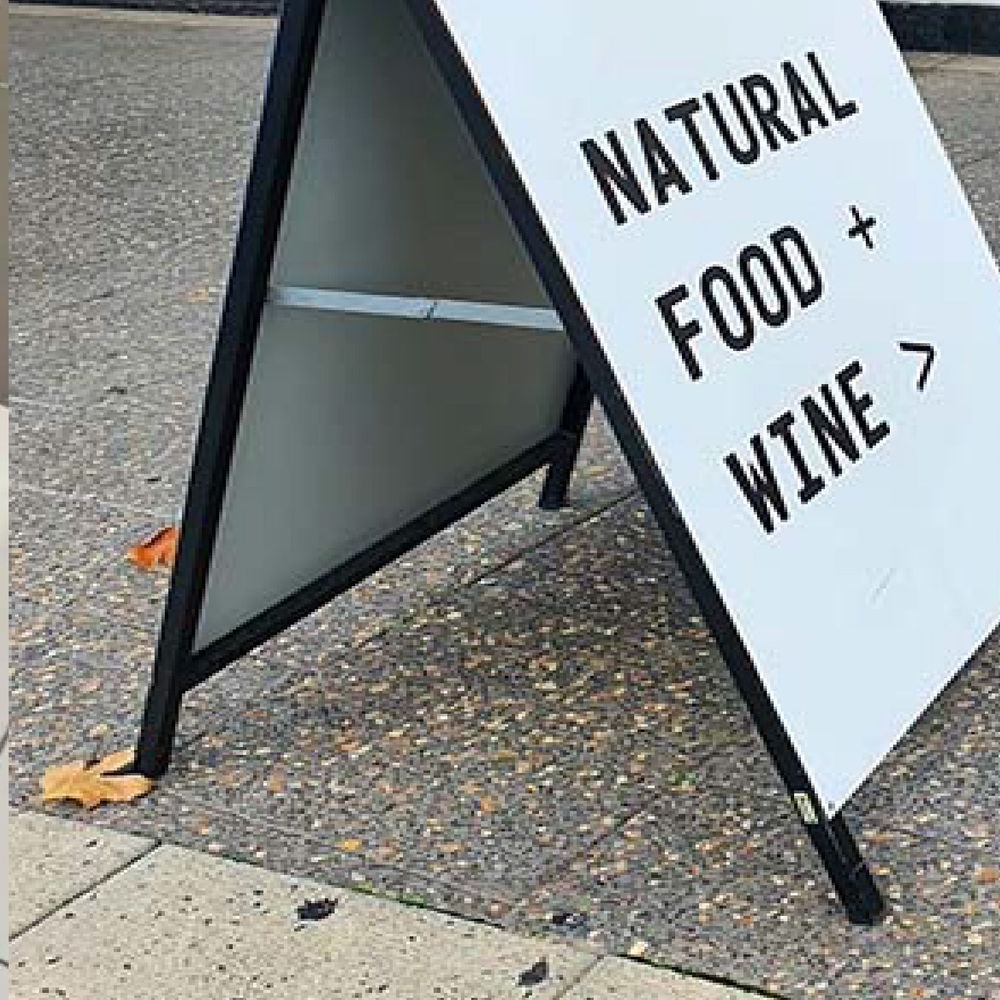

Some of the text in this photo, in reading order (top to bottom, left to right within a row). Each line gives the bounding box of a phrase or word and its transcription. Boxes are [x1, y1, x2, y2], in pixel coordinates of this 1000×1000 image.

[580, 51, 859, 226] NATURAL
[655, 225, 823, 382] FOOD
[723, 360, 891, 535] WINE
